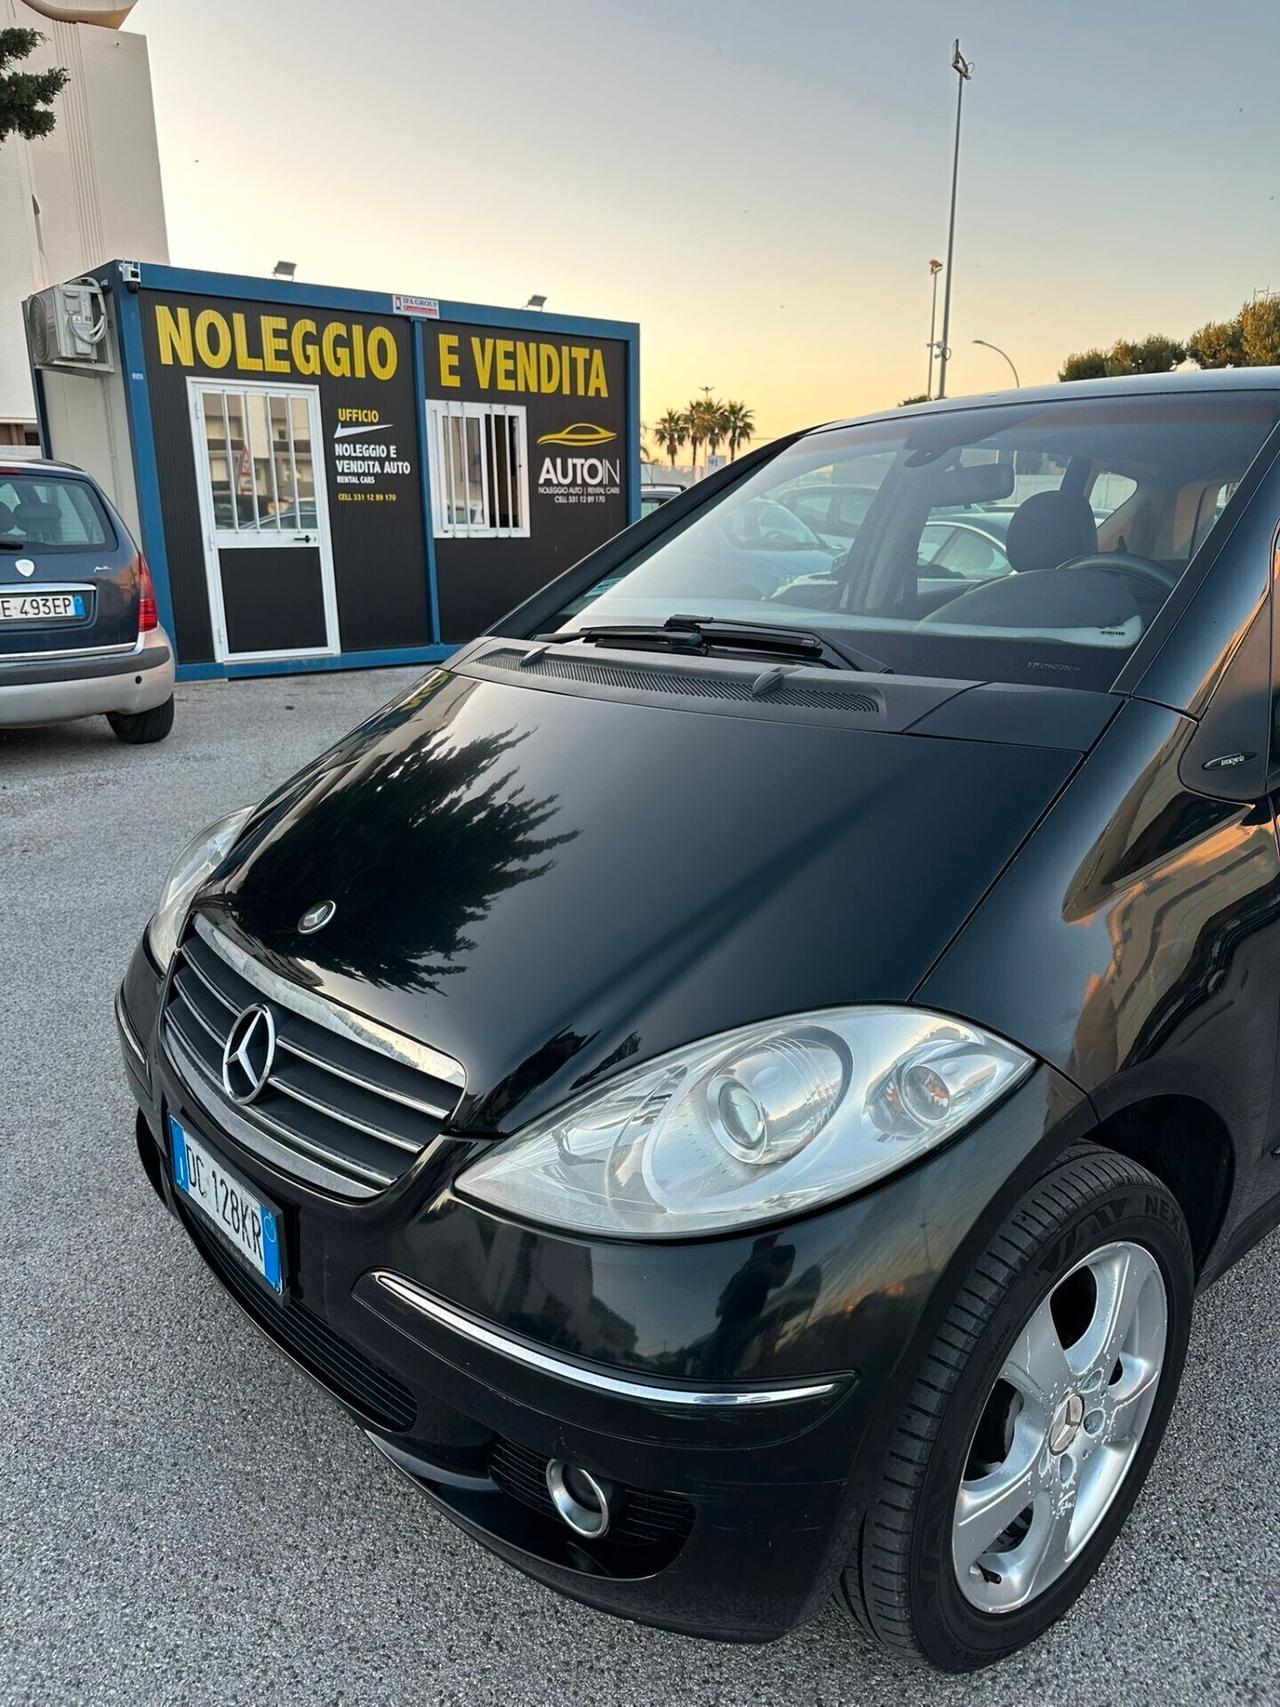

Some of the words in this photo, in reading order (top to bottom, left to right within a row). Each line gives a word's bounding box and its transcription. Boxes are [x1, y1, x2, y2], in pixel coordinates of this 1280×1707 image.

[155, 304, 398, 381] NOLEGGIO
[438, 333, 461, 388] E
[471, 336, 609, 398] VENDITA
[338, 408, 379, 423] UFFICIO
[334, 443, 387, 458] NOLEGGIO
[389, 445, 397, 458] E
[335, 460, 382, 474] VENDITA
[383, 461, 411, 474] AUTO
[336, 475, 359, 484] RENTAL
[360, 475, 375, 484] CARS
[538, 486, 568, 494] NOLEGGIO
[568, 486, 583, 494] AUTO
[587, 486, 605, 494] RENTAL
[605, 486, 620, 494] CARS
[338, 493, 352, 501] CELL
[353, 493, 365, 501] 331
[367, 493, 375, 502] 12
[554, 495, 568, 503] CELL
[568, 495, 578, 503] 331
[580, 495, 586, 503] 12
[595, 495, 606, 503] 170
[20, 597, 72, 617] 493EP
[186, 1144, 207, 1198] DC
[212, 1170, 264, 1261] 128KR
